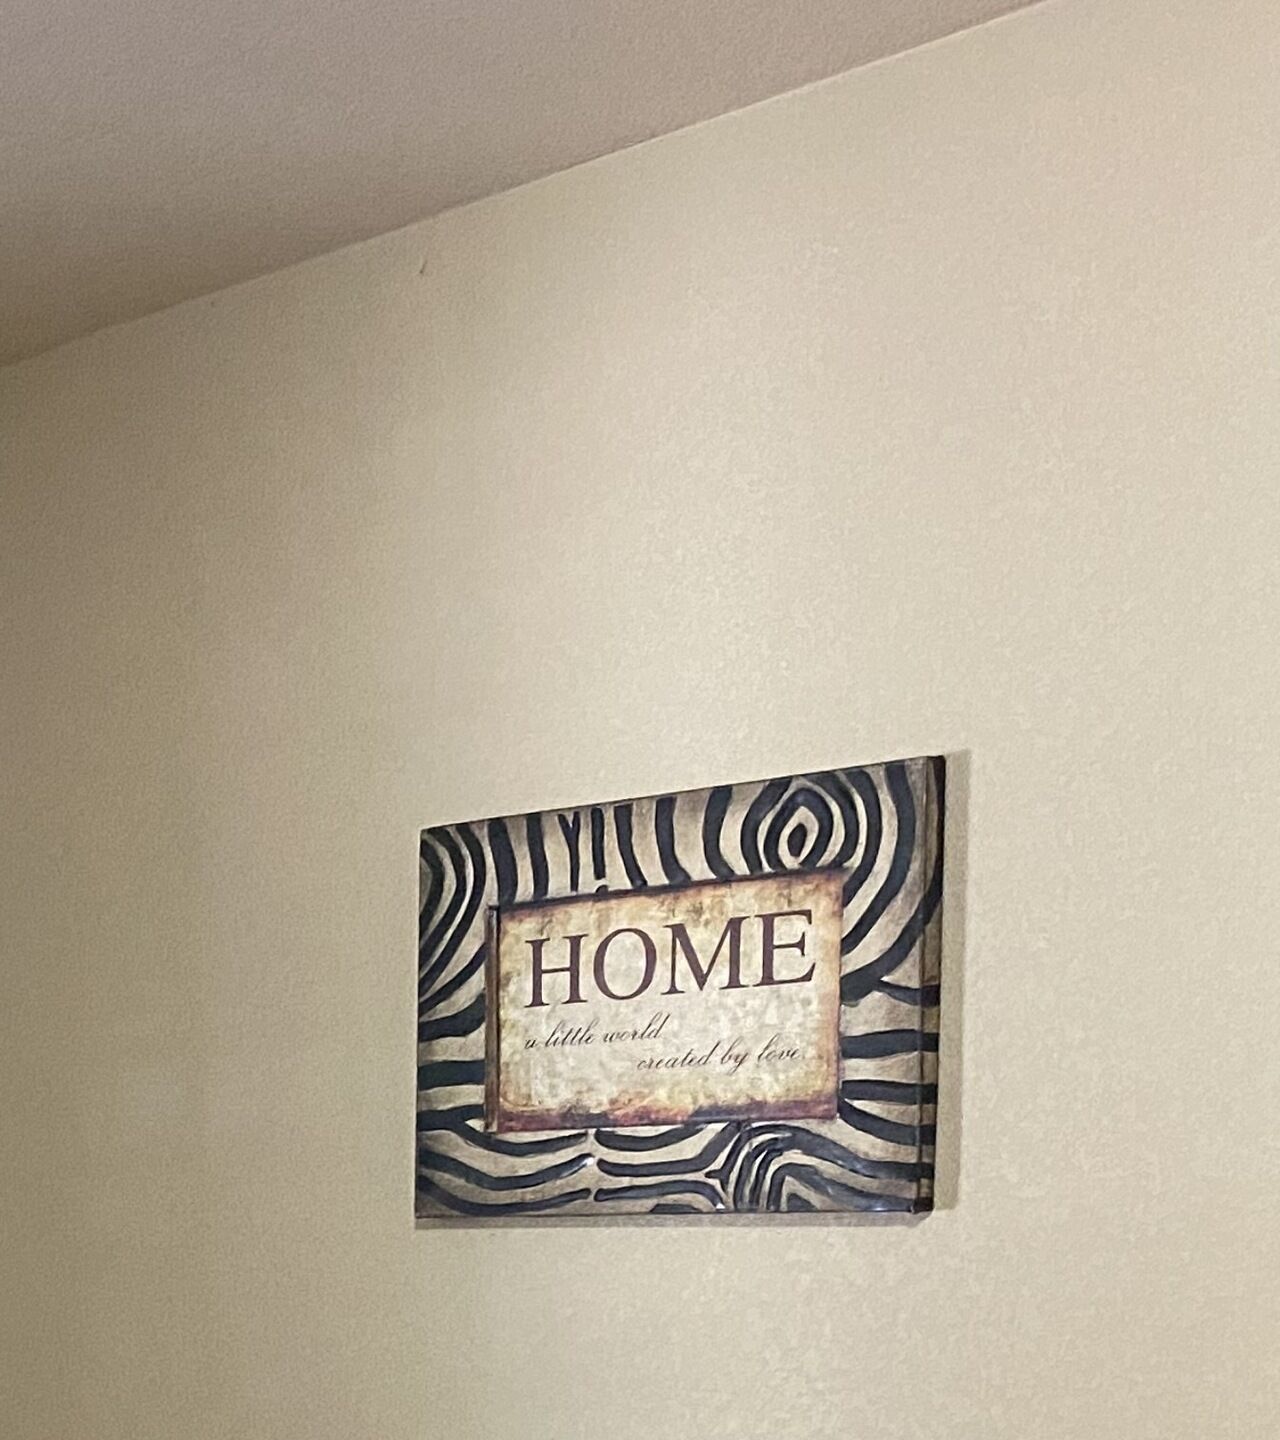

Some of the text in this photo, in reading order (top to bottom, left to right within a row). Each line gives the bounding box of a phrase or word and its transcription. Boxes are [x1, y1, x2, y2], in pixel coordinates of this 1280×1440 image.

[524, 909, 817, 1009] HOME
[545, 1019, 600, 1048] little
[603, 1010, 671, 1043] world
[636, 1040, 721, 1070] created
[720, 1037, 749, 1076] by
